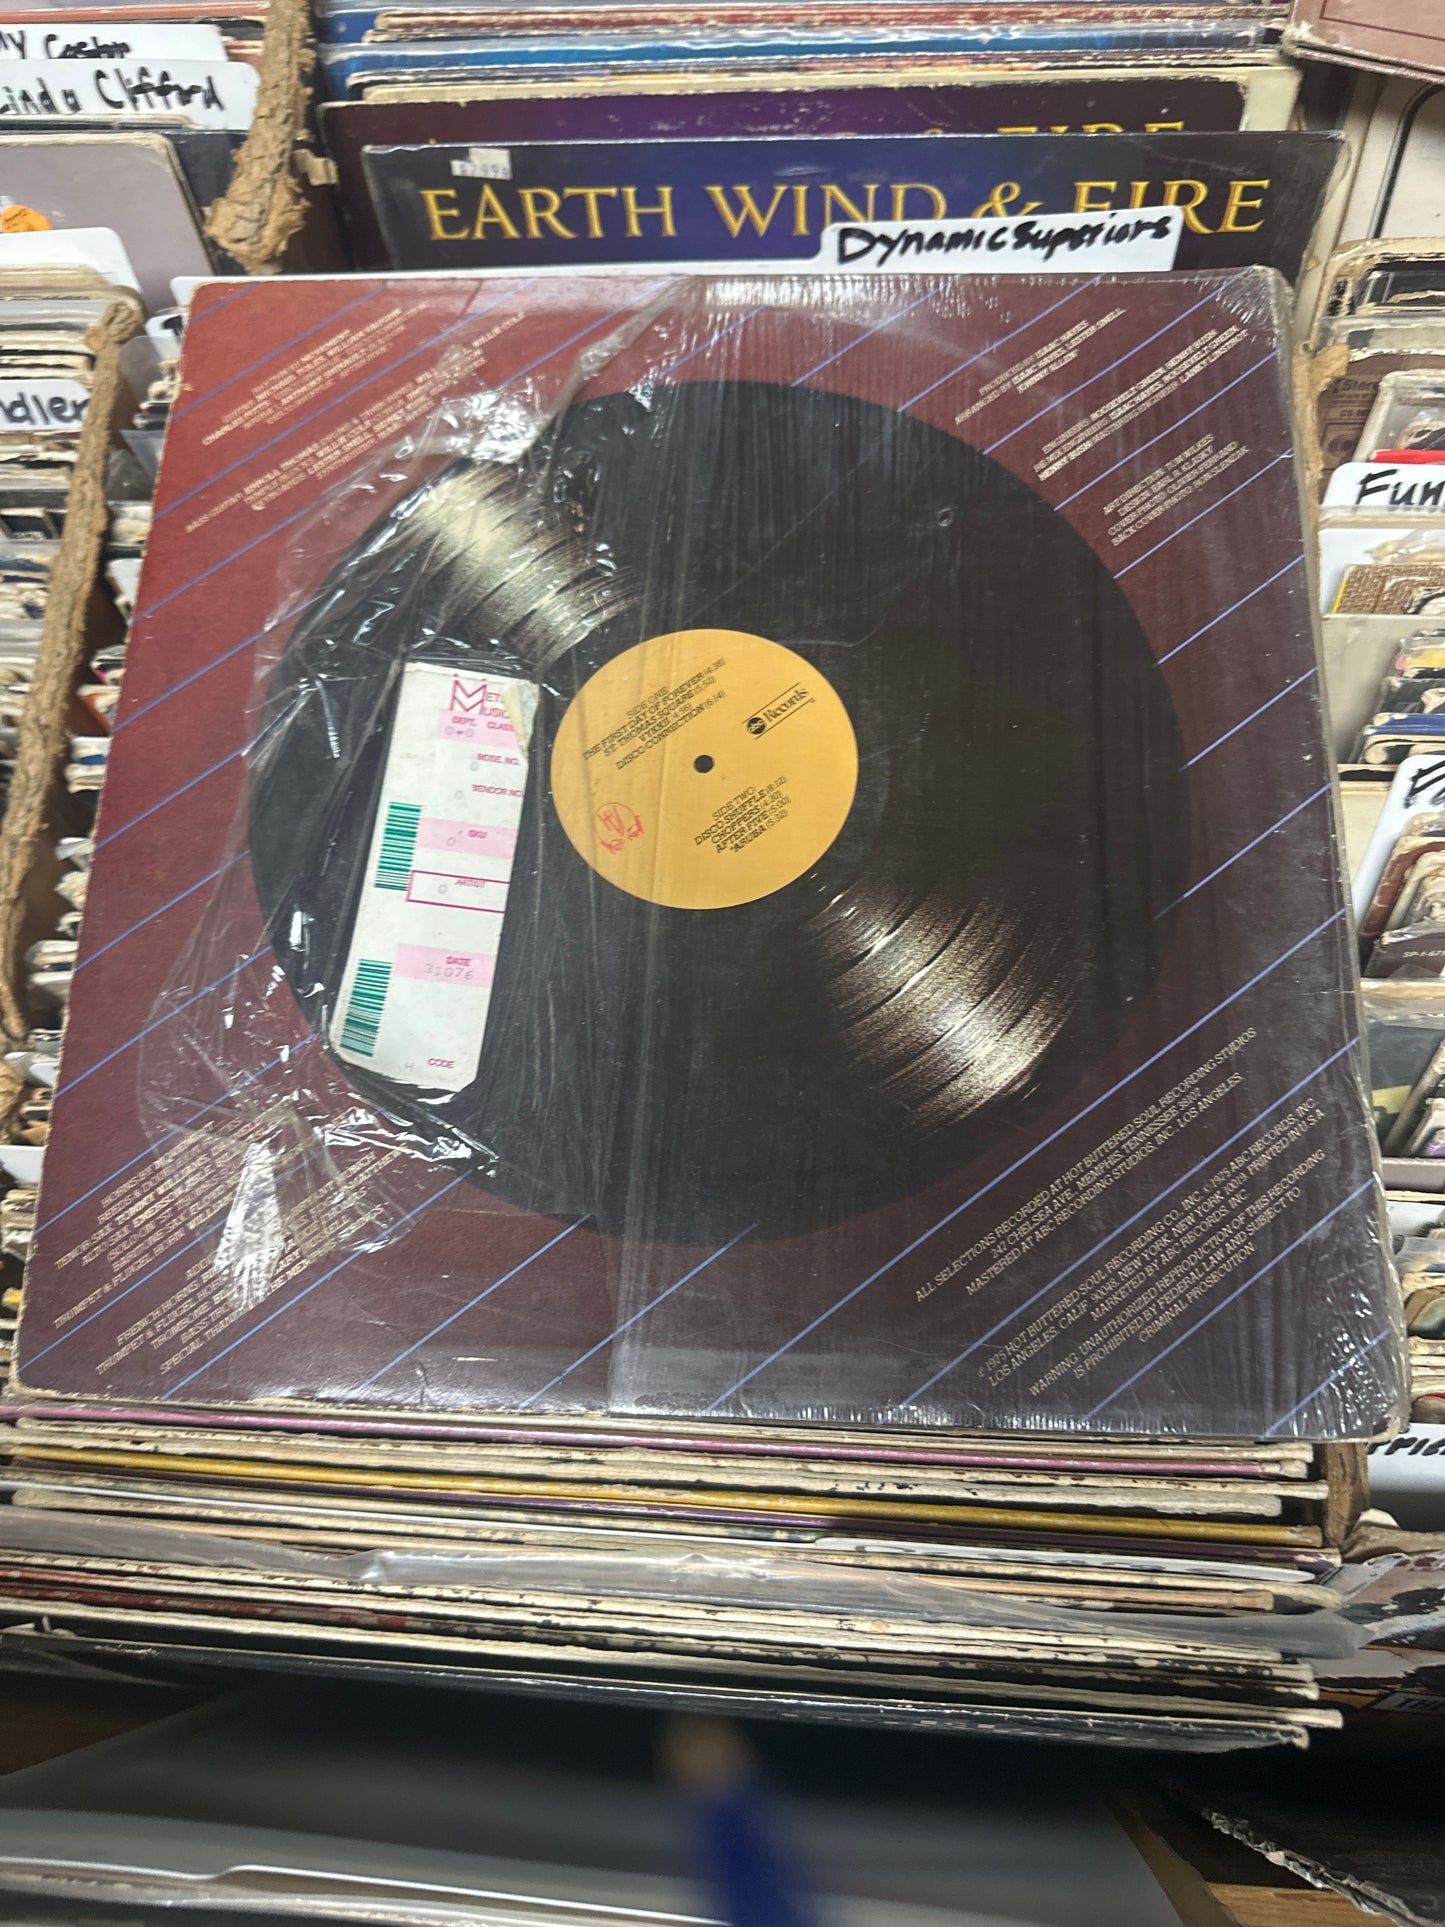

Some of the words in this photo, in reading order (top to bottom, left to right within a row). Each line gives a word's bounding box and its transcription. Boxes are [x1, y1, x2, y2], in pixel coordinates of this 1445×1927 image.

[420, 184, 678, 241] EARTH
[705, 183, 948, 238] WIND
[1073, 178, 1271, 234] FIRE
[1011, 363, 1039, 385] ISAAC
[1065, 324, 1097, 350] LESTER
[1034, 337, 1061, 359] ISAAC
[1059, 318, 1089, 343] HAYES
[1016, 367, 1050, 394] JOHNNY
[1088, 384, 1137, 422] ROOSEVELT
[1163, 344, 1195, 370] HENRY
[1192, 328, 1218, 350] BUSH
[1107, 397, 1135, 420] ISAAC
[1160, 344, 1210, 383] ROOSEVELT
[1038, 455, 1069, 481] HENRY
[1177, 357, 1209, 383] LANKY
[1102, 497, 1121, 515] ART
[1164, 453, 1184, 471] TOM
[1182, 432, 1215, 459] WILKES
[1150, 473, 1173, 493] EARL
[1180, 444, 1214, 472] KLASKY
[1107, 510, 1138, 537] COVER
[1111, 524, 1137, 547] BACK
[1135, 504, 1165, 530] COVER
[582, 742, 601, 760] THE
[600, 723, 628, 747] FIRST
[627, 710, 648, 728] DAY
[648, 701, 661, 714] OF
[660, 671, 703, 705] FOREVER
[617, 715, 656, 746] THOMAS
[656, 689, 693, 718] SQUARE
[625, 699, 648, 719] SIDE
[763, 684, 808, 723] Records
[615, 745, 645, 770] DISCO
[644, 704, 704, 749] CONNECTION
[468, 829, 487, 839] SKU
[694, 819, 724, 845] DISCO
[723, 788, 766, 824] SHUFFLE
[710, 804, 761, 845] CHOPPERS
[711, 800, 734, 821] SIDE
[714, 826, 747, 853] AFTER
[745, 809, 770, 831] FIVE
[446, 956, 472, 967] DATE
[428, 1057, 455, 1069] CODE
[915, 1280, 935, 1302] ALL
[934, 1231, 996, 1286] SELECTIONS
[995, 1189, 1050, 1238] RECORDED
[1049, 1178, 1063, 1196] AT
[1062, 1160, 1085, 1185] HOT
[1083, 1122, 1134, 1168] BUTTERED
[1133, 1102, 1159, 1129] SOUL
[1159, 1058, 1216, 1108] RECORDING
[1215, 1026, 1256, 1064] STUDIOS
[991, 1239, 1008, 1259] 247
[1007, 1204, 1052, 1246] CHELSEA
[1122, 1105, 1178, 1154] TENNESSEE
[967, 1247, 1020, 1295] MASTERED
[1021, 1236, 1034, 1252] AT
[1033, 1218, 1056, 1243] ABC
[1054, 1173, 1113, 1224] RECORDING
[1177, 1106, 1197, 1128] LOS
[989, 1363, 1011, 1387] LOS
[1118, 1255, 1144, 1282] NEW
[1172, 1212, 1195, 1237] NEW
[1195, 1190, 1223, 1218] YORK
[1247, 1135, 1289, 1176] PRINTED
[1288, 1126, 1300, 1142] IN
[1005, 1330, 1029, 1355] HOT
[1027, 1288, 1080, 1337] BUTTERED
[1078, 1267, 1105, 1295] SOUL
[1105, 1220, 1164, 1273] RECORDING
[1210, 1166, 1230, 1188] 1975
[1229, 1149, 1251, 1173] ABC
[1079, 1285, 1157, 1355] UNAUTHORIZED
[1156, 1223, 1232, 1292] REPRODUCTION
[1231, 1211, 1247, 1230] OF
[1246, 1193, 1269, 1217] THIS
[1267, 1147, 1324, 1200] RECORDING
[1073, 1363, 1085, 1379] IS
[1083, 1315, 1144, 1370] PROHIBITED
[1142, 1303, 1158, 1321] BY
[1157, 1266, 1202, 1309] FEDERAL
[1202, 1247, 1225, 1272] LAW
[1224, 1229, 1247, 1254] AND
[1245, 1195, 1288, 1236] SUBJECT
[1286, 1184, 1301, 1202] TO
[1090, 1270, 1146, 1322] MARKETED
[1145, 1259, 1160, 1277] BY
[1159, 1242, 1181, 1265] ABC
[1138, 1297, 1187, 1343] CRIMINAL
[1186, 1241, 1255, 1303] PROSECUTION
[116, 1306, 162, 1345] FRENCH
[179, 1316, 209, 1344] BASS
[95, 1333, 146, 1376] TRUMPET
[158, 1337, 203, 1375] SPECIAL
